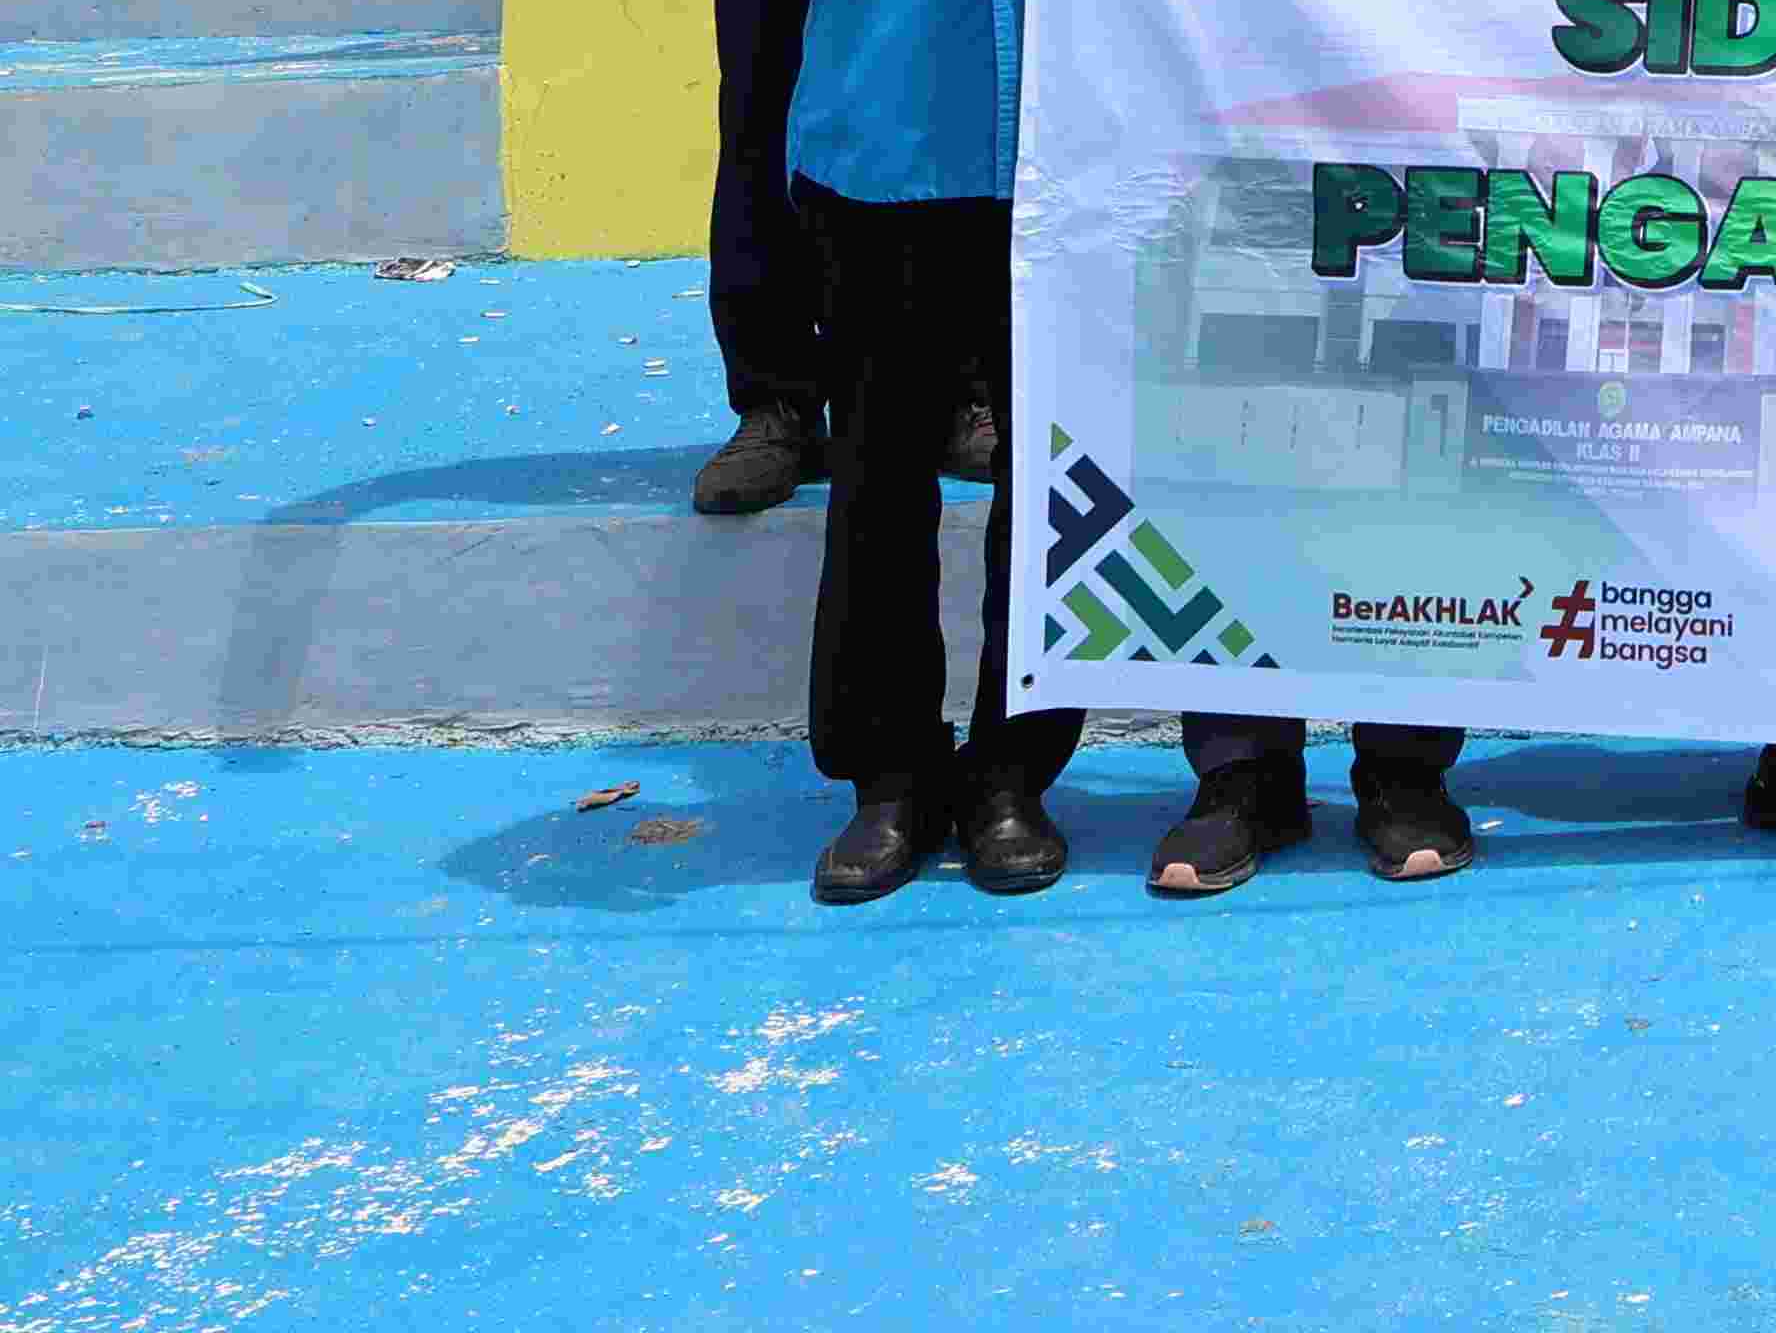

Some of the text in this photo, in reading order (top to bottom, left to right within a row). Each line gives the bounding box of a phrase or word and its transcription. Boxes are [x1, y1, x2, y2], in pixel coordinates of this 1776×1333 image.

[1482, 413, 1743, 445] PENGADILAN AGAMA AMPANA
[1576, 442, 1641, 462] KLAS II
[1331, 591, 1522, 627] BerAKHLAK
[1601, 581, 1713, 614] bangga
[1600, 609, 1734, 641] melayani
[1599, 636, 1708, 670] bangsa
